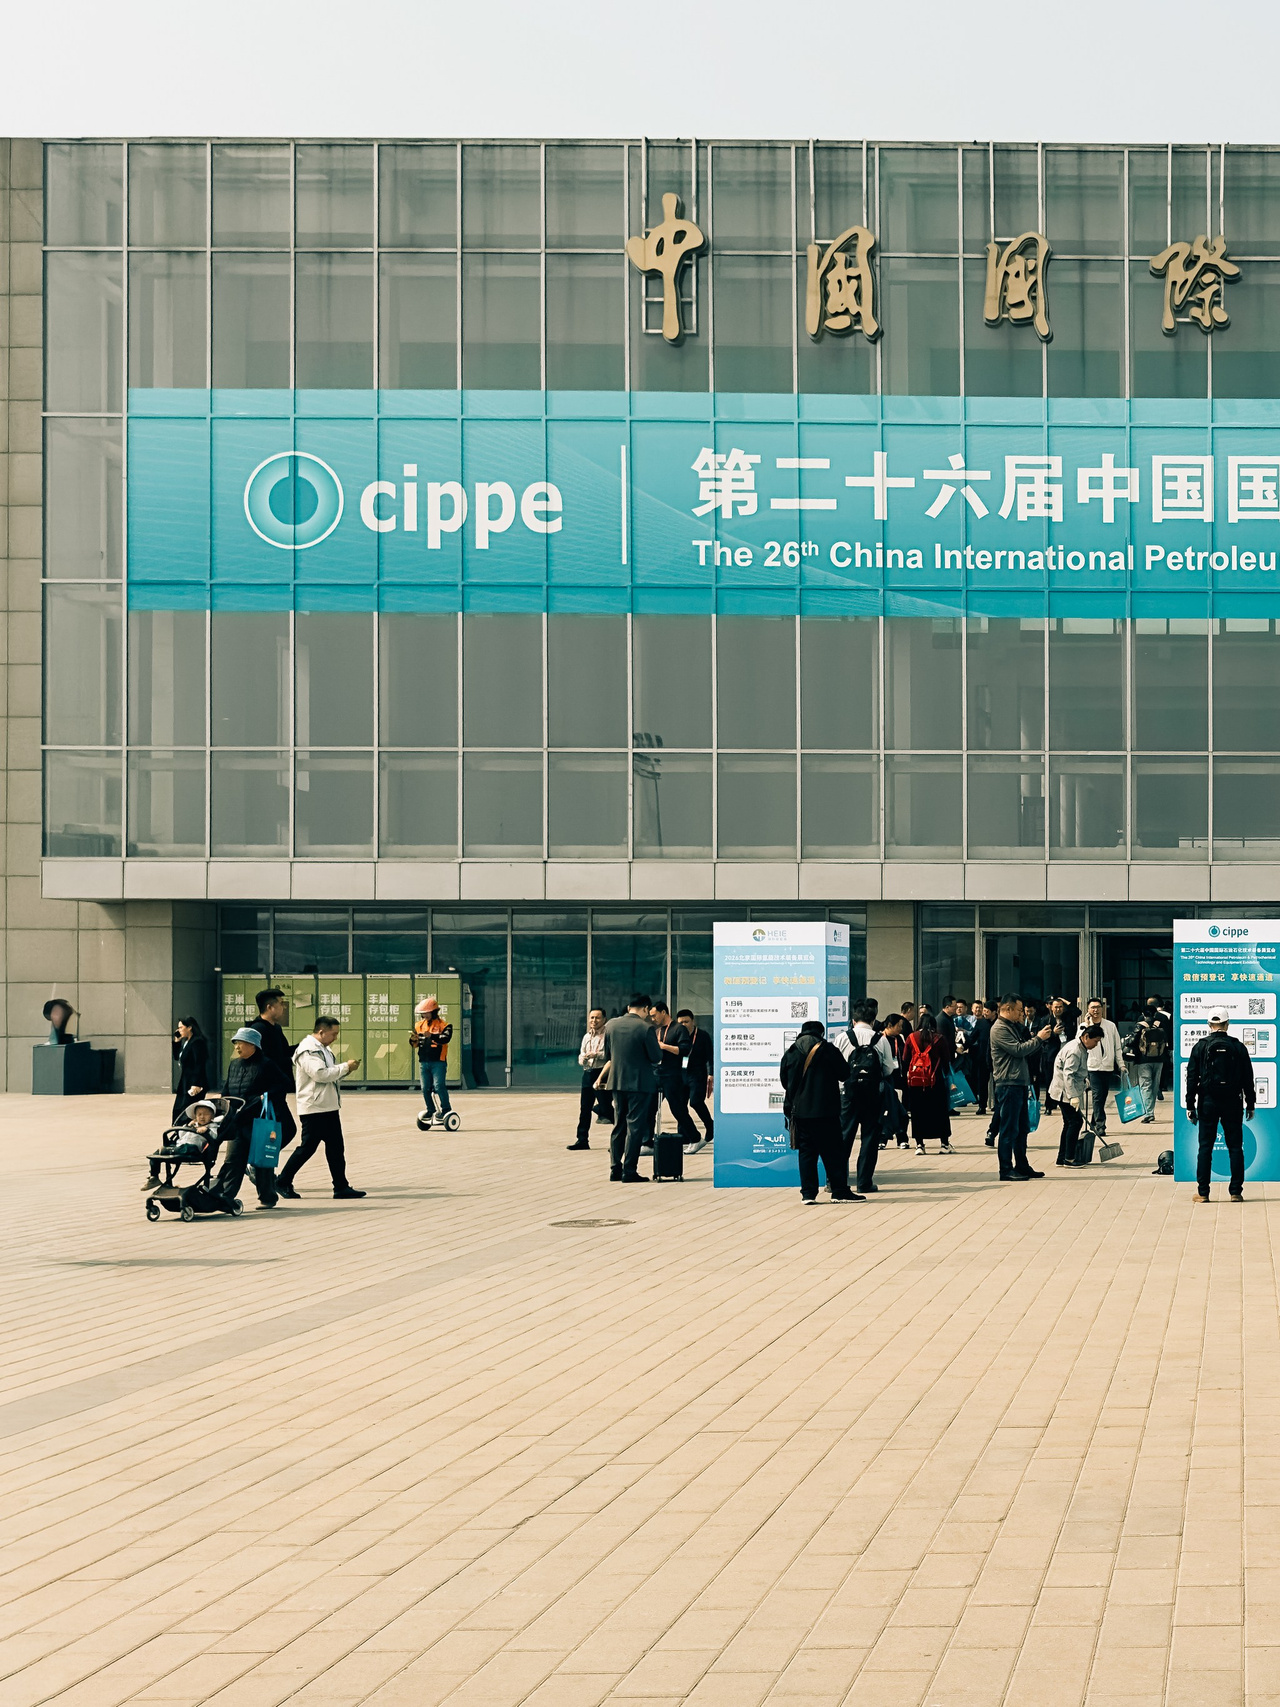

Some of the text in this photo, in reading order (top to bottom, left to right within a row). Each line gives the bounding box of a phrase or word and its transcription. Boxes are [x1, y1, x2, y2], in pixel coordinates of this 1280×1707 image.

[359, 463, 564, 550] cippe
[692, 540, 752, 566] The
[764, 541, 818, 567] 26th
[830, 542, 922, 568] China
[935, 544, 1133, 570] International
[1222, 926, 1249, 938] cippe
[369, 994, 388, 1004] 丰巢
[224, 1005, 255, 1015] 存包柜
[320, 1005, 351, 1015] 存包柜
[369, 1005, 399, 1015] 存包柜
